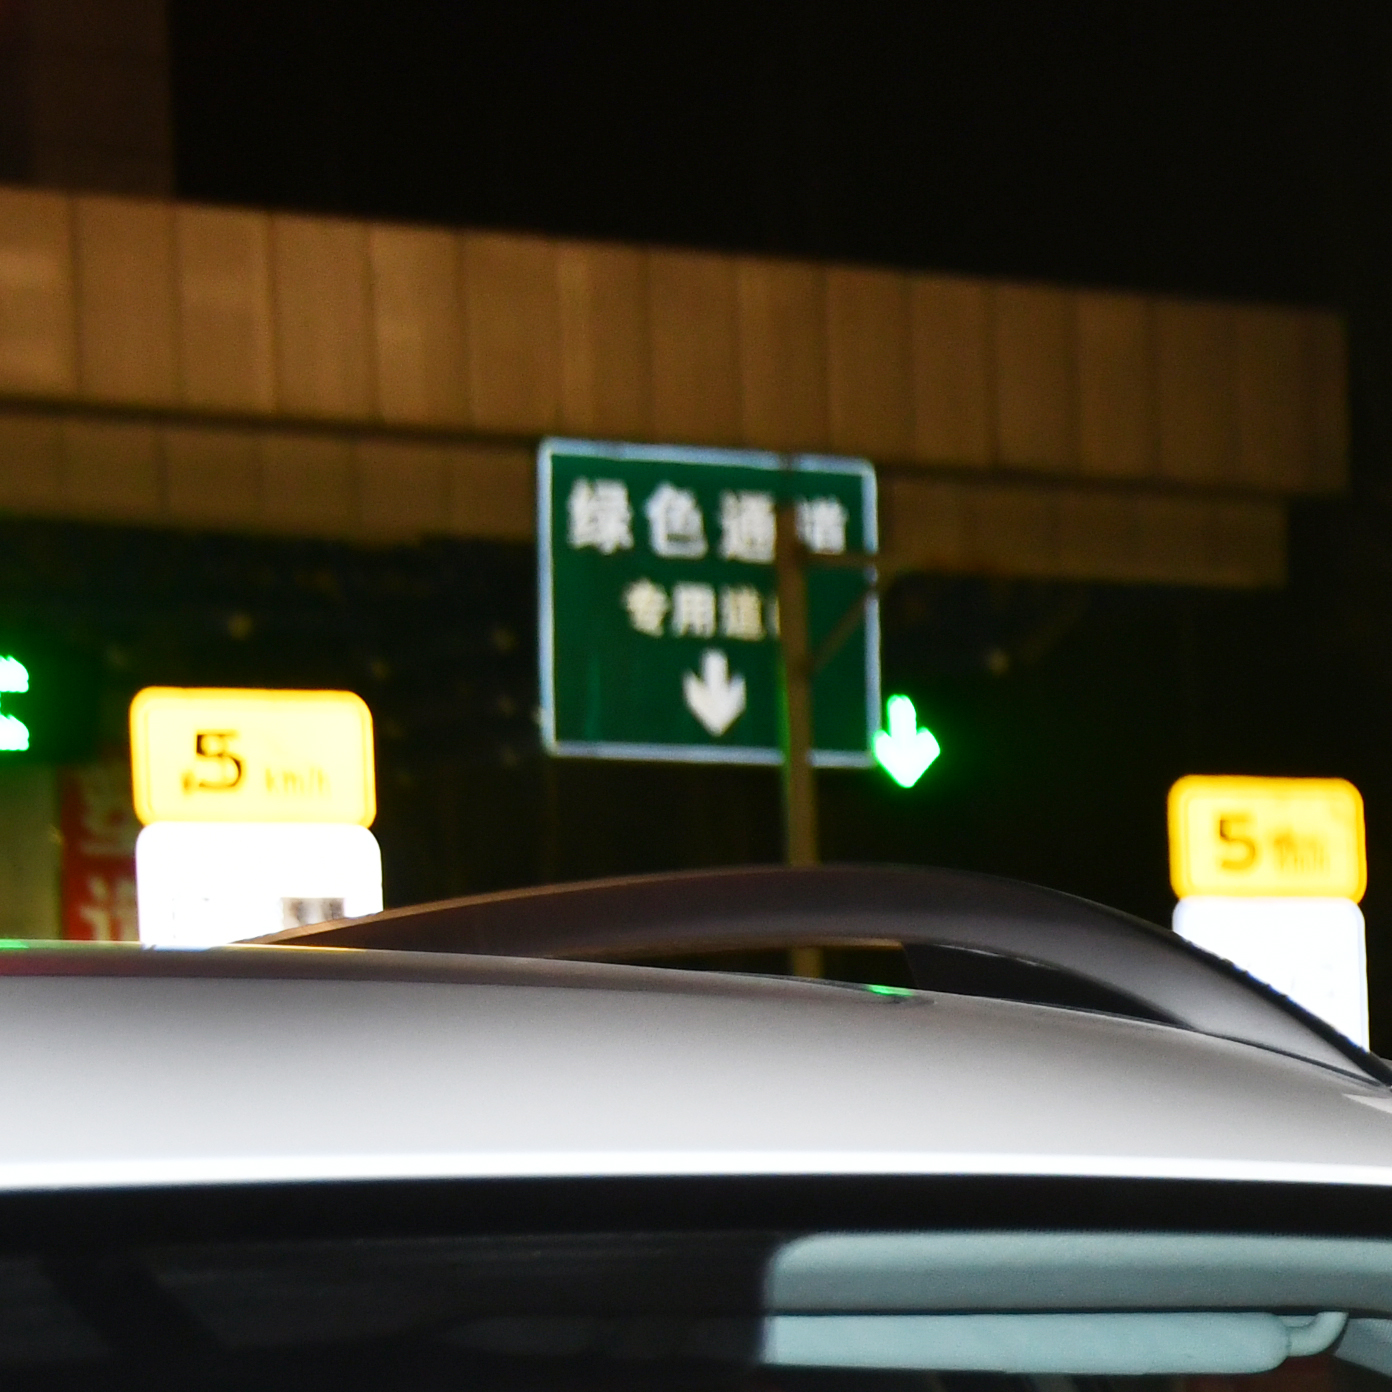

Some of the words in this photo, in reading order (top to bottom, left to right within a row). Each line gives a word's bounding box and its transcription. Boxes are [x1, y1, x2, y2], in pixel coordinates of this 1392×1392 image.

[623, 578, 780, 642] 专用道
[1218, 813, 1256, 871] 5
